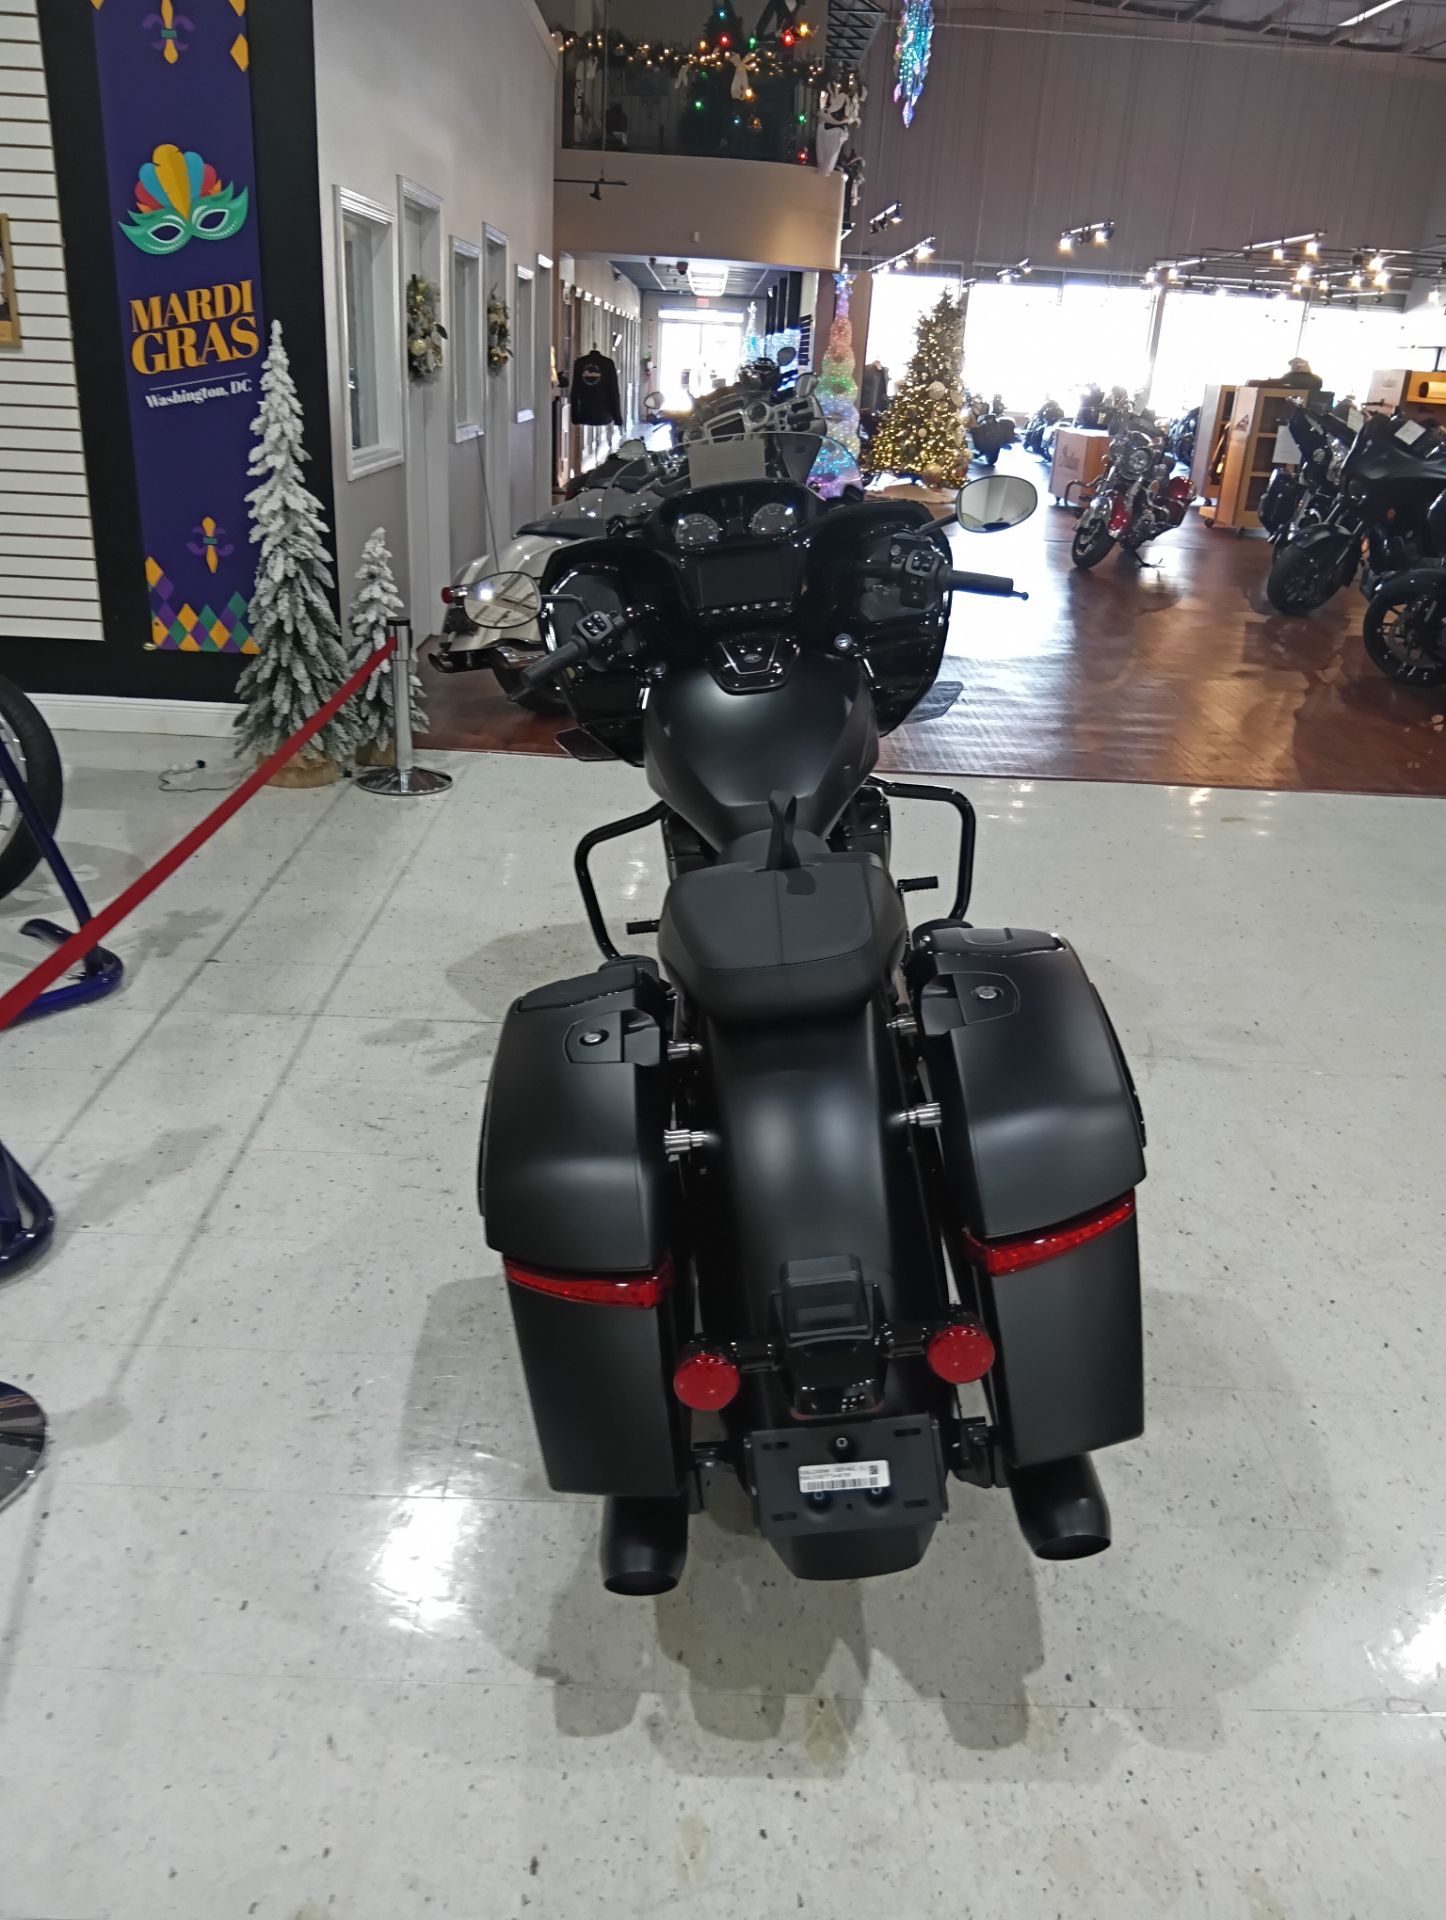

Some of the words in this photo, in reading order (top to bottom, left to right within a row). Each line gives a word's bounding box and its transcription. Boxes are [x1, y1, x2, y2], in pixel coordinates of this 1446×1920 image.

[129, 280, 254, 332] MARDI
[132, 316, 259, 375] GRAS
[145, 386, 229, 408] Washington,
[230, 379, 252, 394] DC
